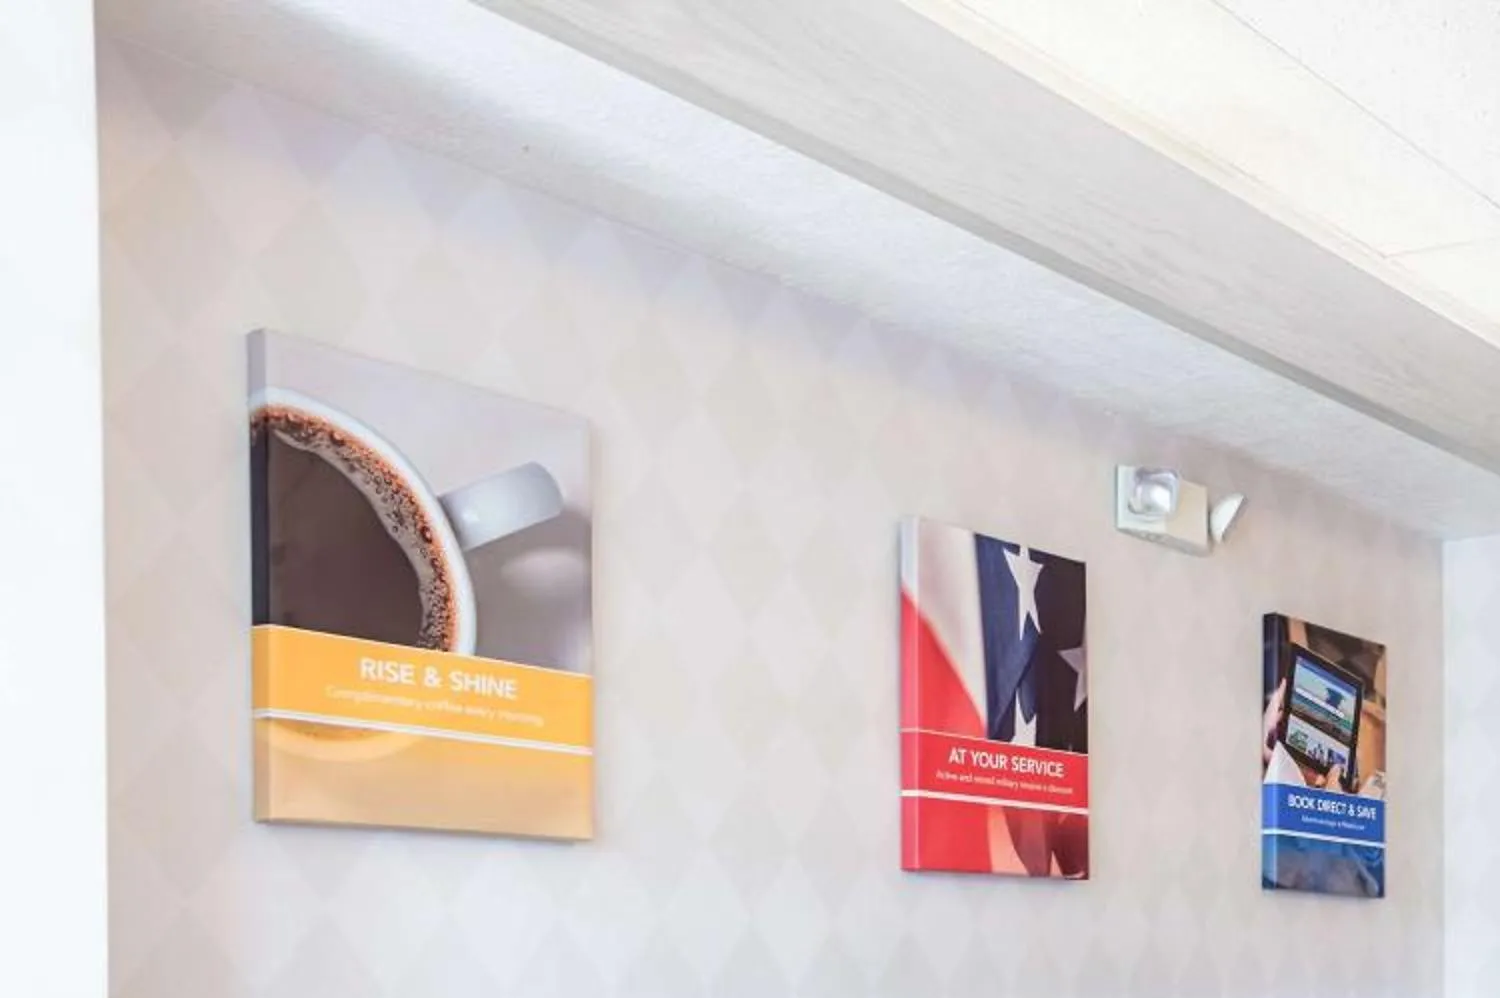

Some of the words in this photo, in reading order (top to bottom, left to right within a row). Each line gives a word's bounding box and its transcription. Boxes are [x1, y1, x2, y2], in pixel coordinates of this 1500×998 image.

[360, 656, 417, 686] RISE
[424, 665, 442, 689] &
[448, 670, 519, 701] SHINE
[948, 747, 967, 766] AT
[970, 749, 1009, 771] YOUR
[1011, 755, 1065, 778] SERVICE
[1287, 794, 1316, 810] BOOK
[1317, 799, 1347, 815] DIRECT
[1348, 803, 1356, 817] &
[1357, 805, 1377, 820] SAVE
